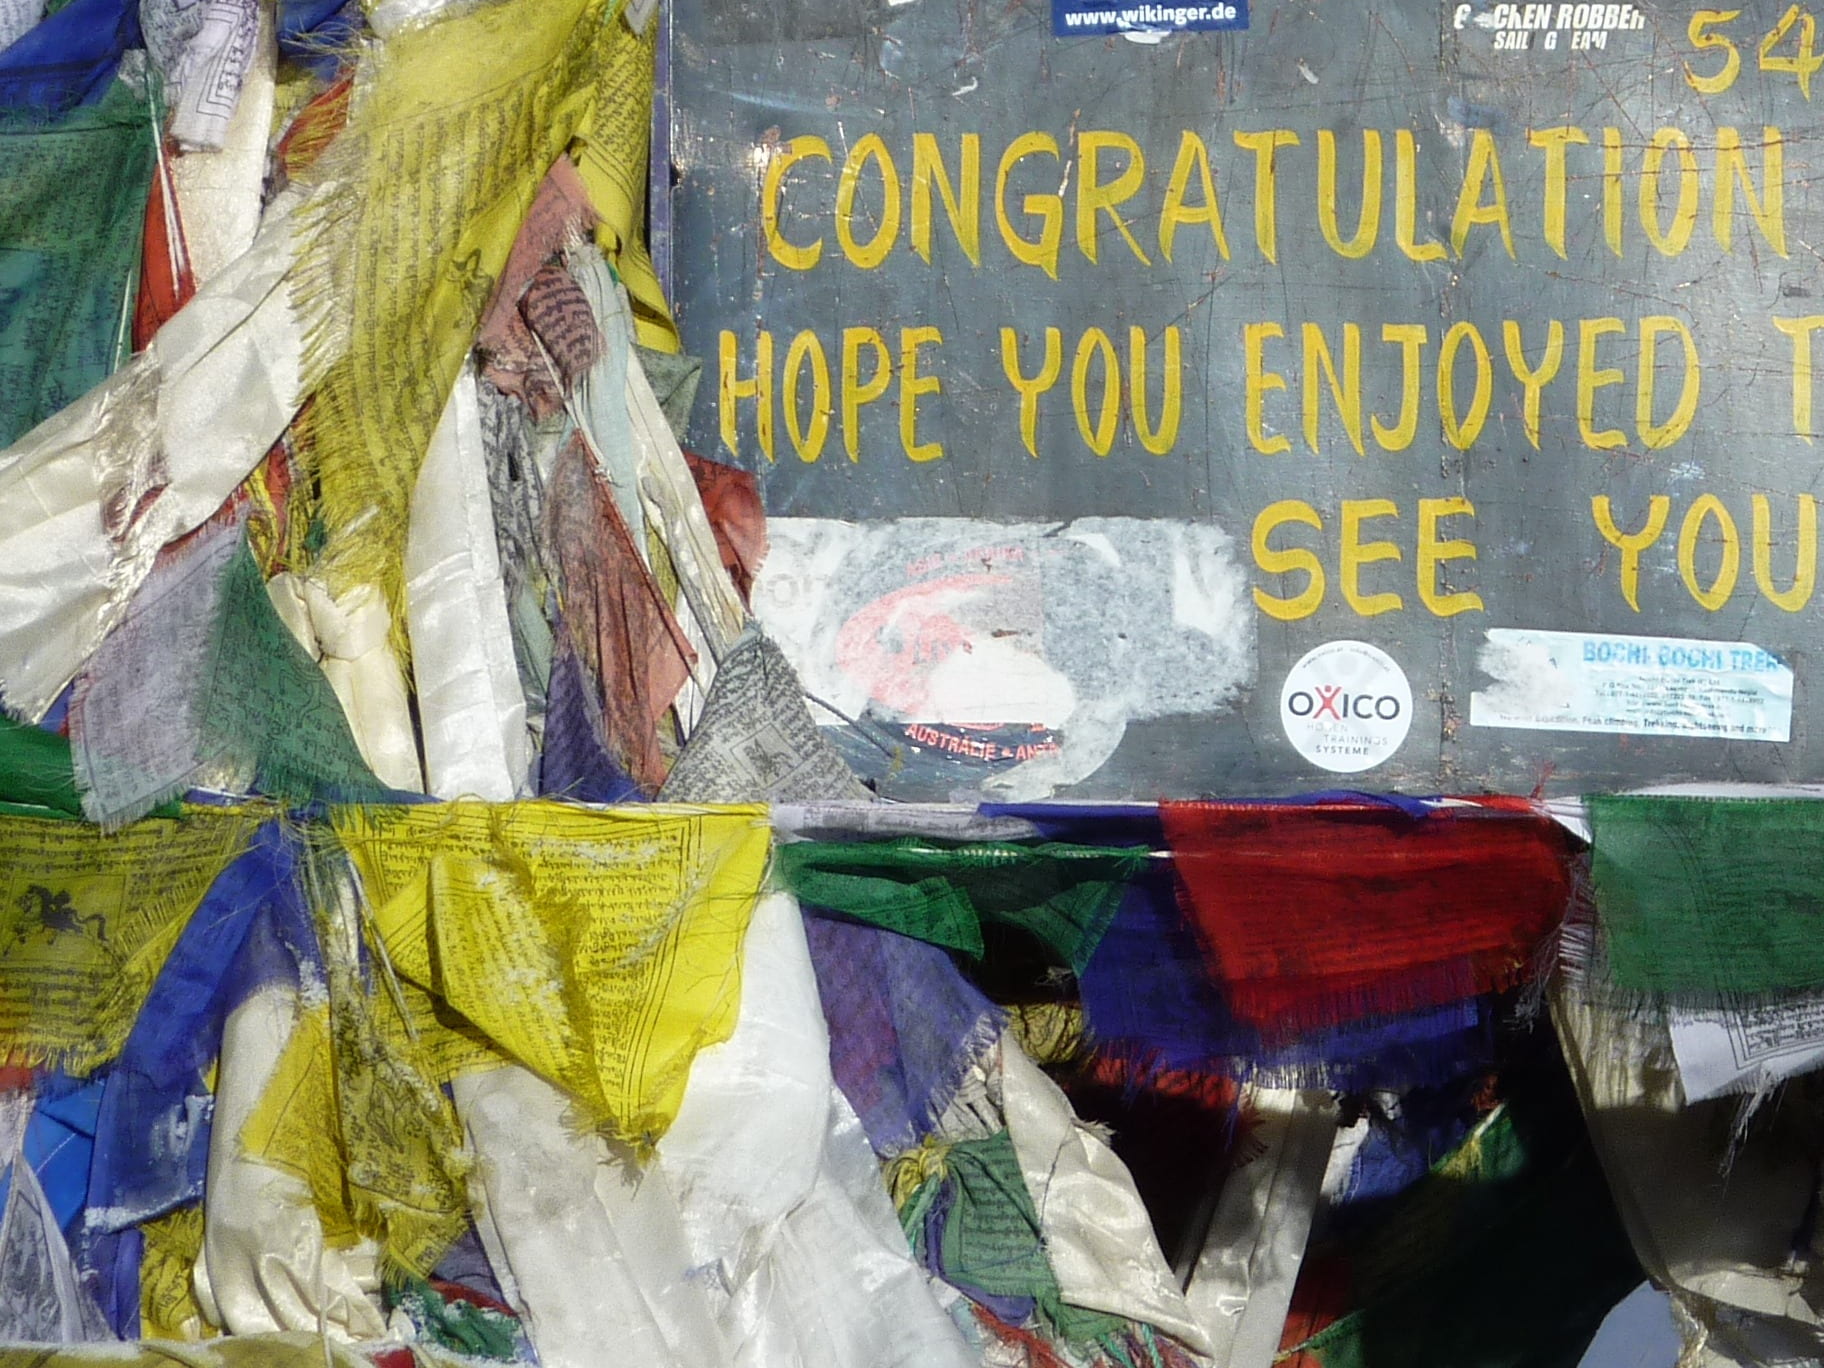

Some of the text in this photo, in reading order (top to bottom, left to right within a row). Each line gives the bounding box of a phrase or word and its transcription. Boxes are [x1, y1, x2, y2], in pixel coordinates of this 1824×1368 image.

[1065, 2, 1237, 26] www.wikinger.de
[763, 127, 1791, 280] CONGRATULATION
[719, 327, 944, 463] HOPE
[1000, 327, 1182, 458] YOU
[1245, 316, 1699, 455] ENJOYED
[1252, 496, 1484, 621] SEE
[1592, 493, 1817, 614] YOU
[1288, 685, 1401, 721] OXICO
[1315, 745, 1370, 756] SYSTEME
